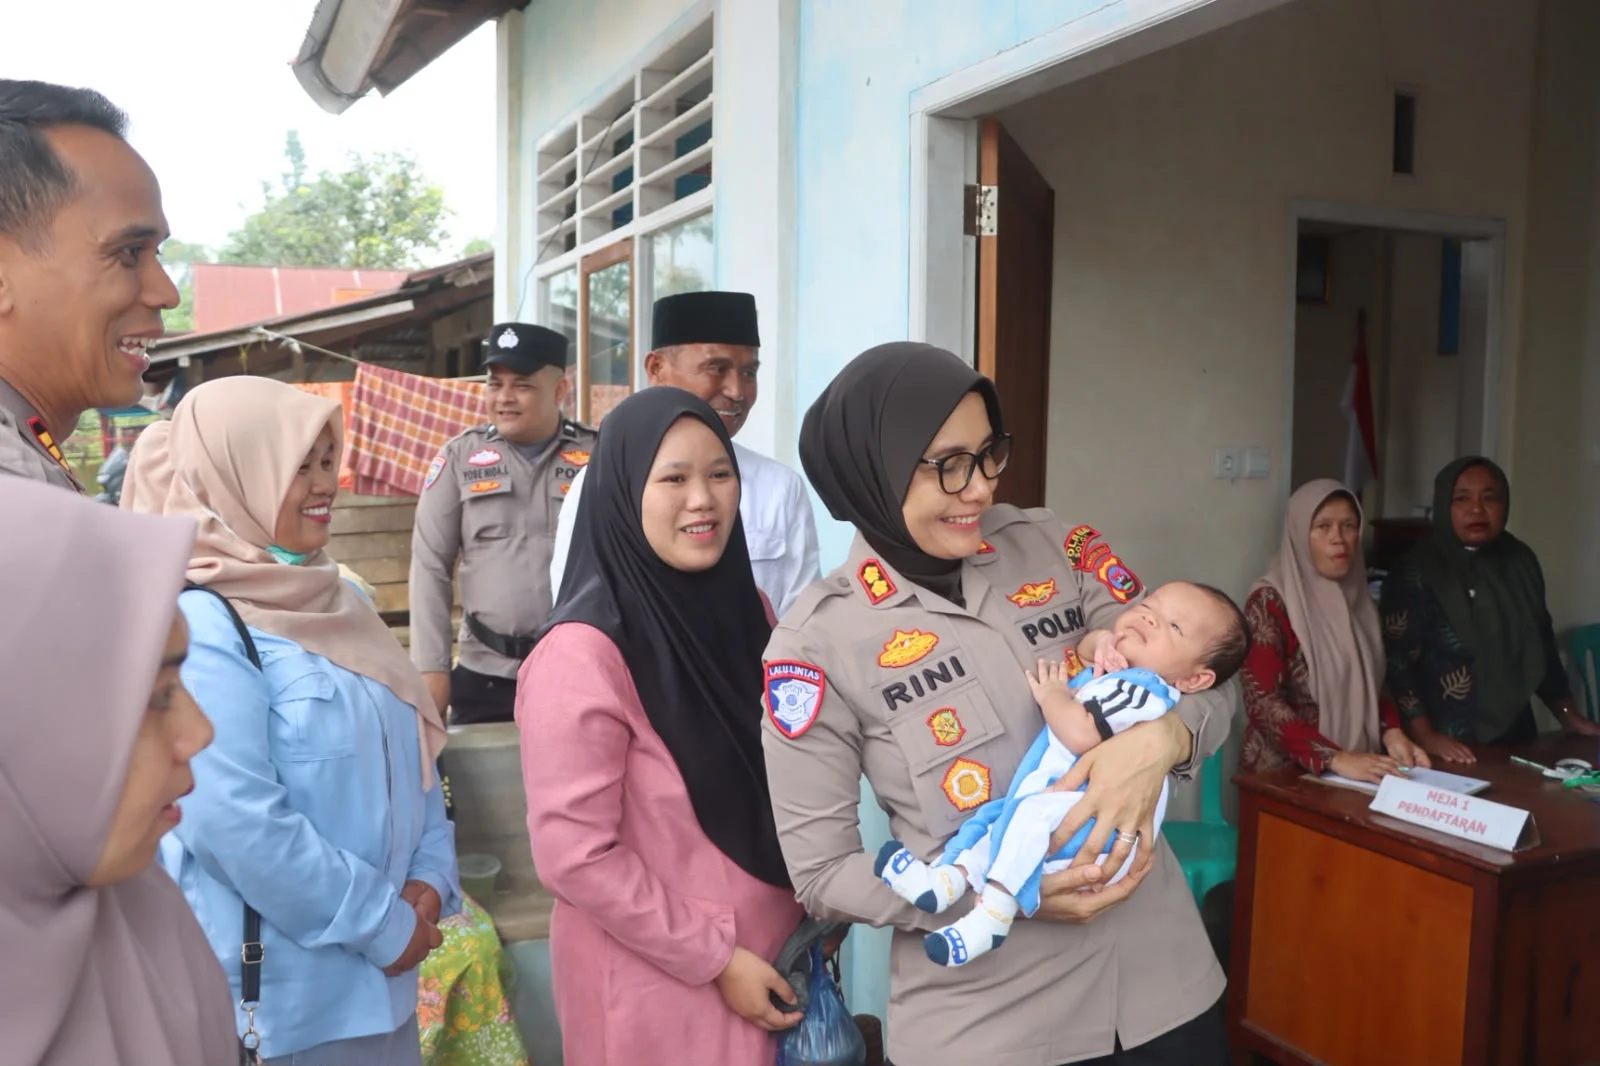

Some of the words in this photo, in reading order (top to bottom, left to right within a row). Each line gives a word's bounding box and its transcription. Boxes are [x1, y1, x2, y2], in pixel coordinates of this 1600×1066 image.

[1021, 606, 1085, 645] POLRI
[882, 655, 966, 711] RINI
[1427, 790, 1458, 807] MEJA
[1397, 802, 1487, 834] PENDAFTARAN
